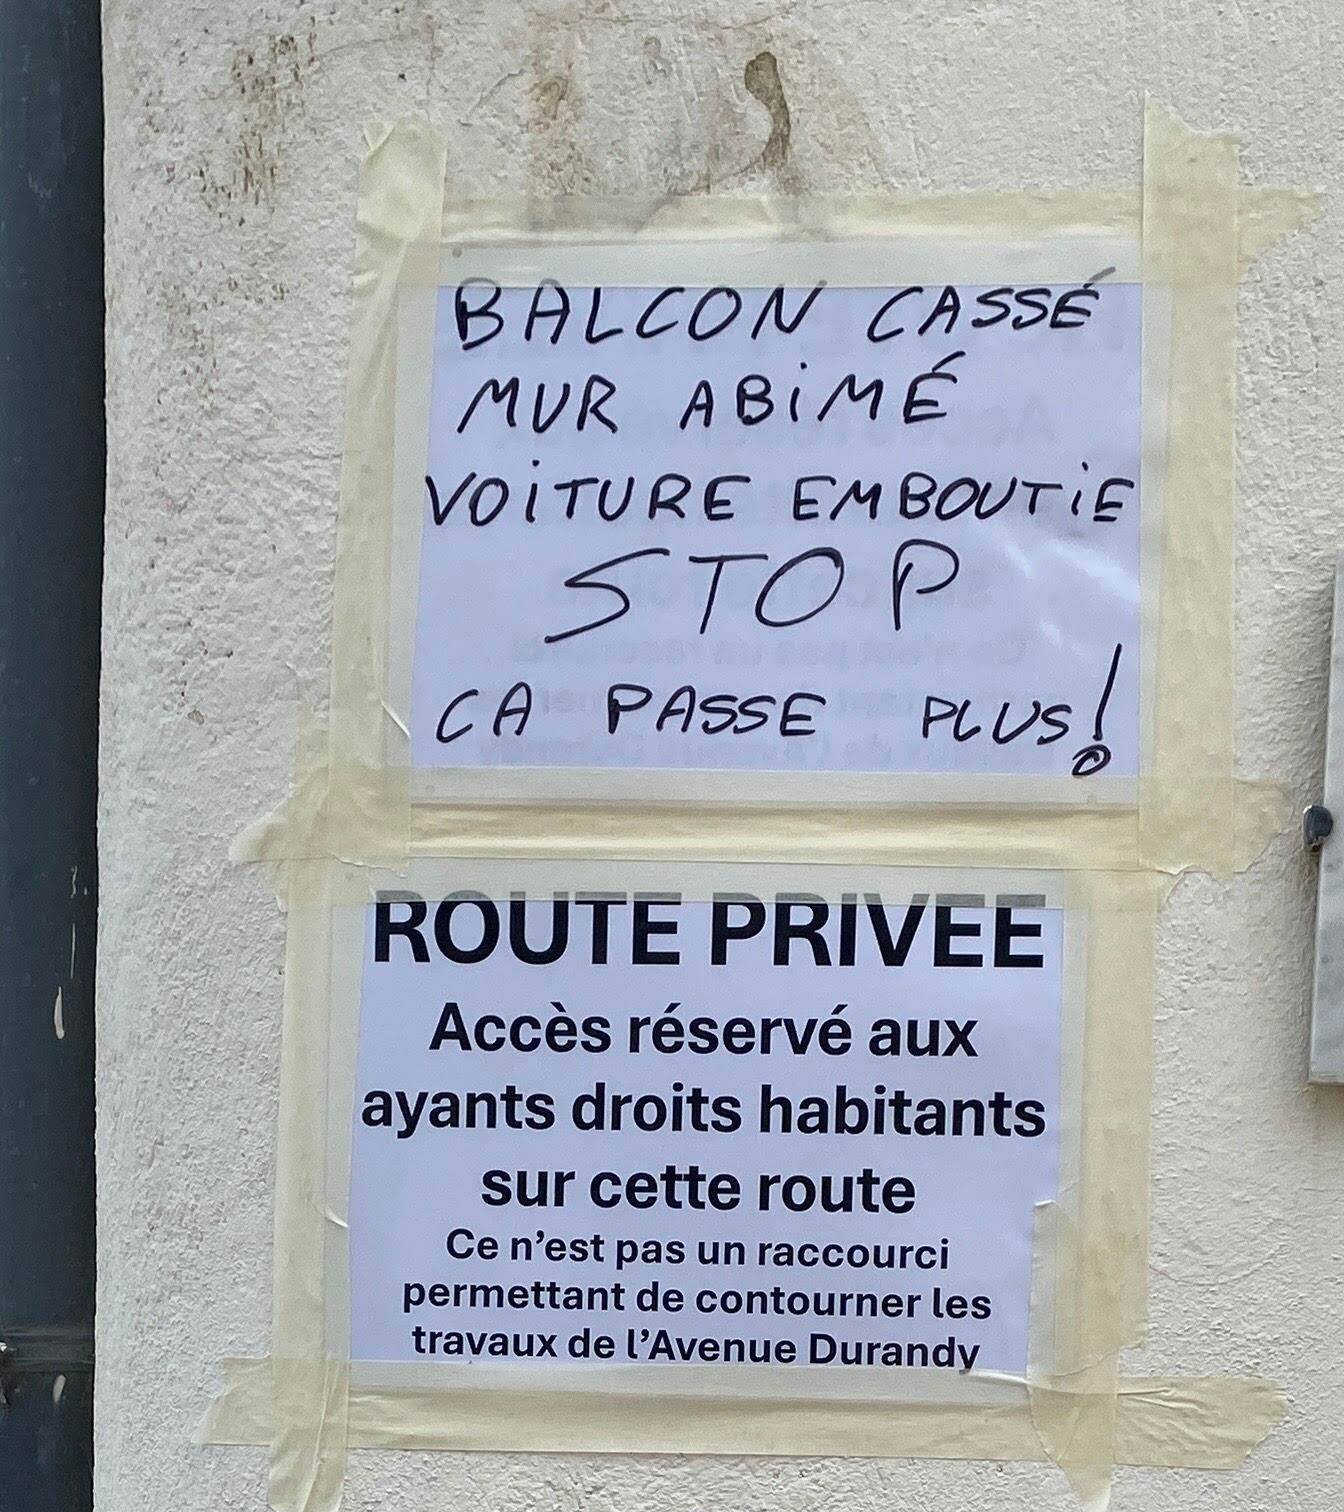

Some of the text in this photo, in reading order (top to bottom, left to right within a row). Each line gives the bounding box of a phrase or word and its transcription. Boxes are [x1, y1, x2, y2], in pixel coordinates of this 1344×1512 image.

[454, 267, 1116, 350] BALCON CASSÉ
[457, 375, 617, 433] MUR
[545, 539, 959, 643] STOP
[436, 682, 531, 743] CA
[608, 684, 826, 737] PASSE
[373, 890, 1047, 968] ROUTE PRIVEE
[429, 1002, 978, 1056] Accès réservé aux
[362, 1082, 1045, 1139] ayants droits habitants
[482, 1166, 915, 1213] sur cette route
[447, 1229, 498, 1259] Ce
[617, 1240, 685, 1270] pas
[699, 1242, 745, 1265] un
[759, 1238, 948, 1269] raccourci
[404, 1281, 991, 1319] permettant de contourner les
[412, 1326, 557, 1357] travaux
[568, 1328, 615, 1358] de
[810, 1334, 980, 1372] Durandy
